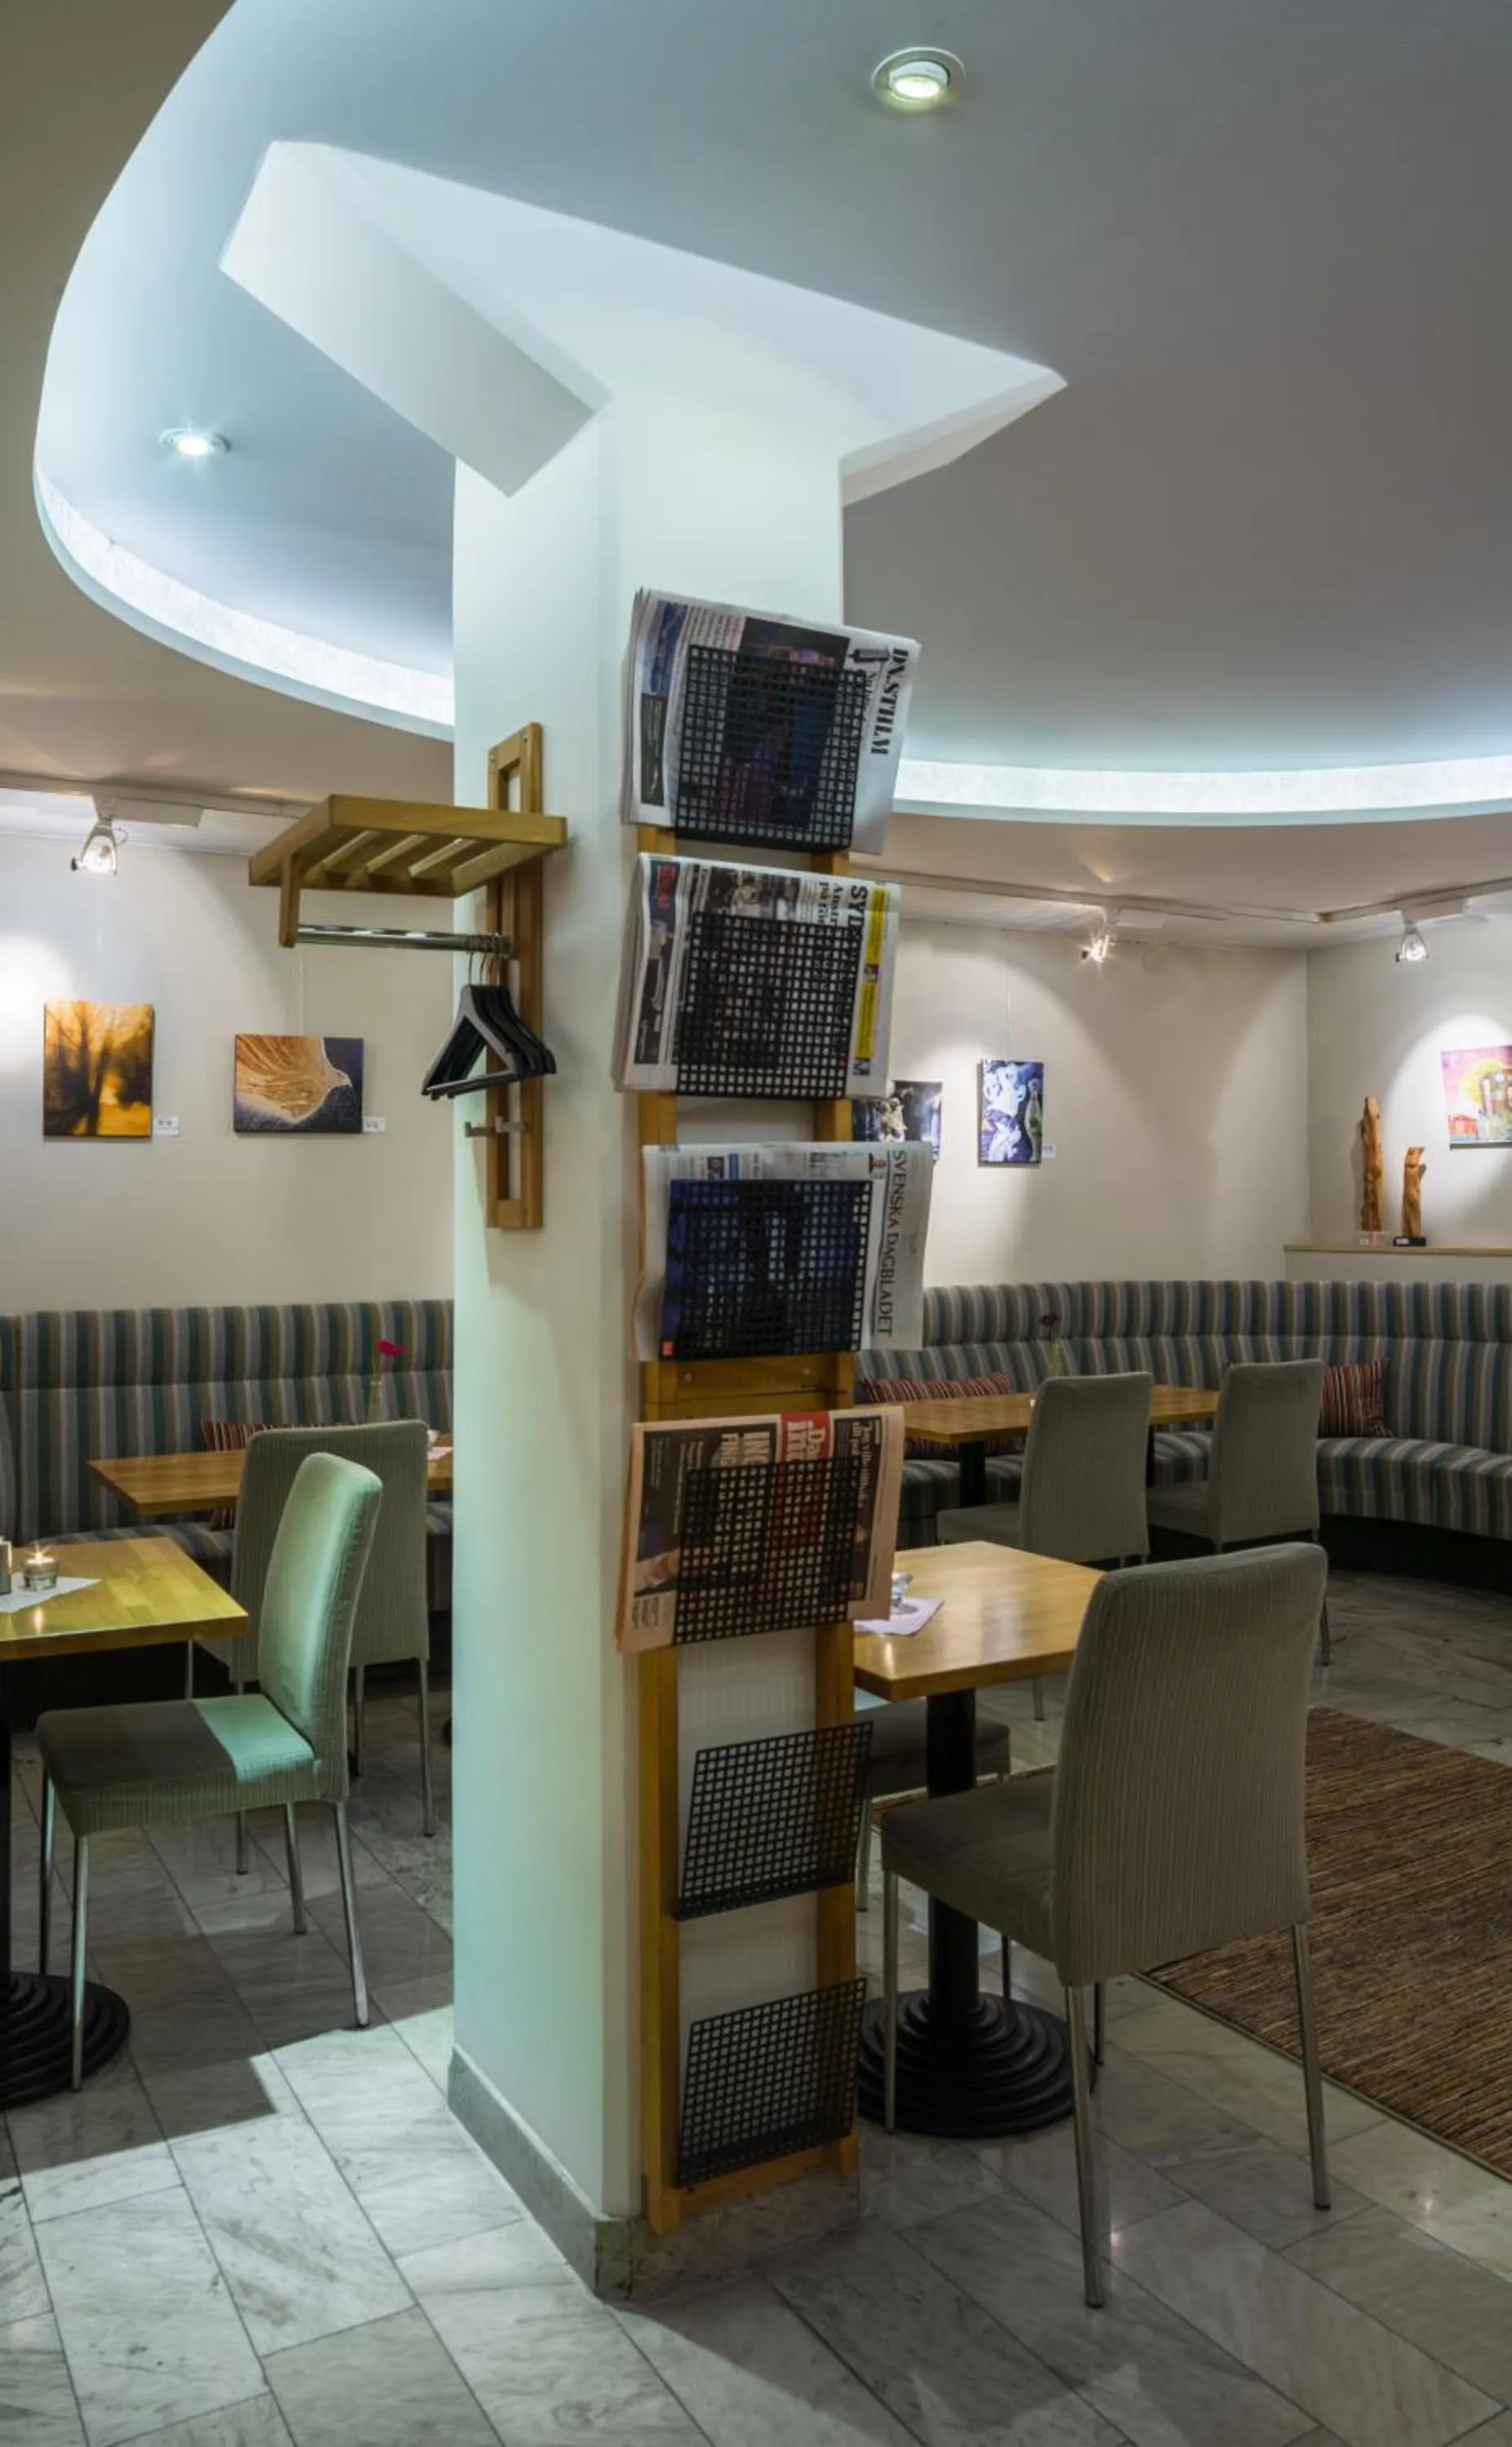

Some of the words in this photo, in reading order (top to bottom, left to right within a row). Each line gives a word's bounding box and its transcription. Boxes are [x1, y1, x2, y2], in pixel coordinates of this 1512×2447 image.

[871, 648, 909, 755] DN.STHLM
[887, 1150, 907, 1229] SVENSKA
[878, 1232, 898, 1338] DAGBLADET
